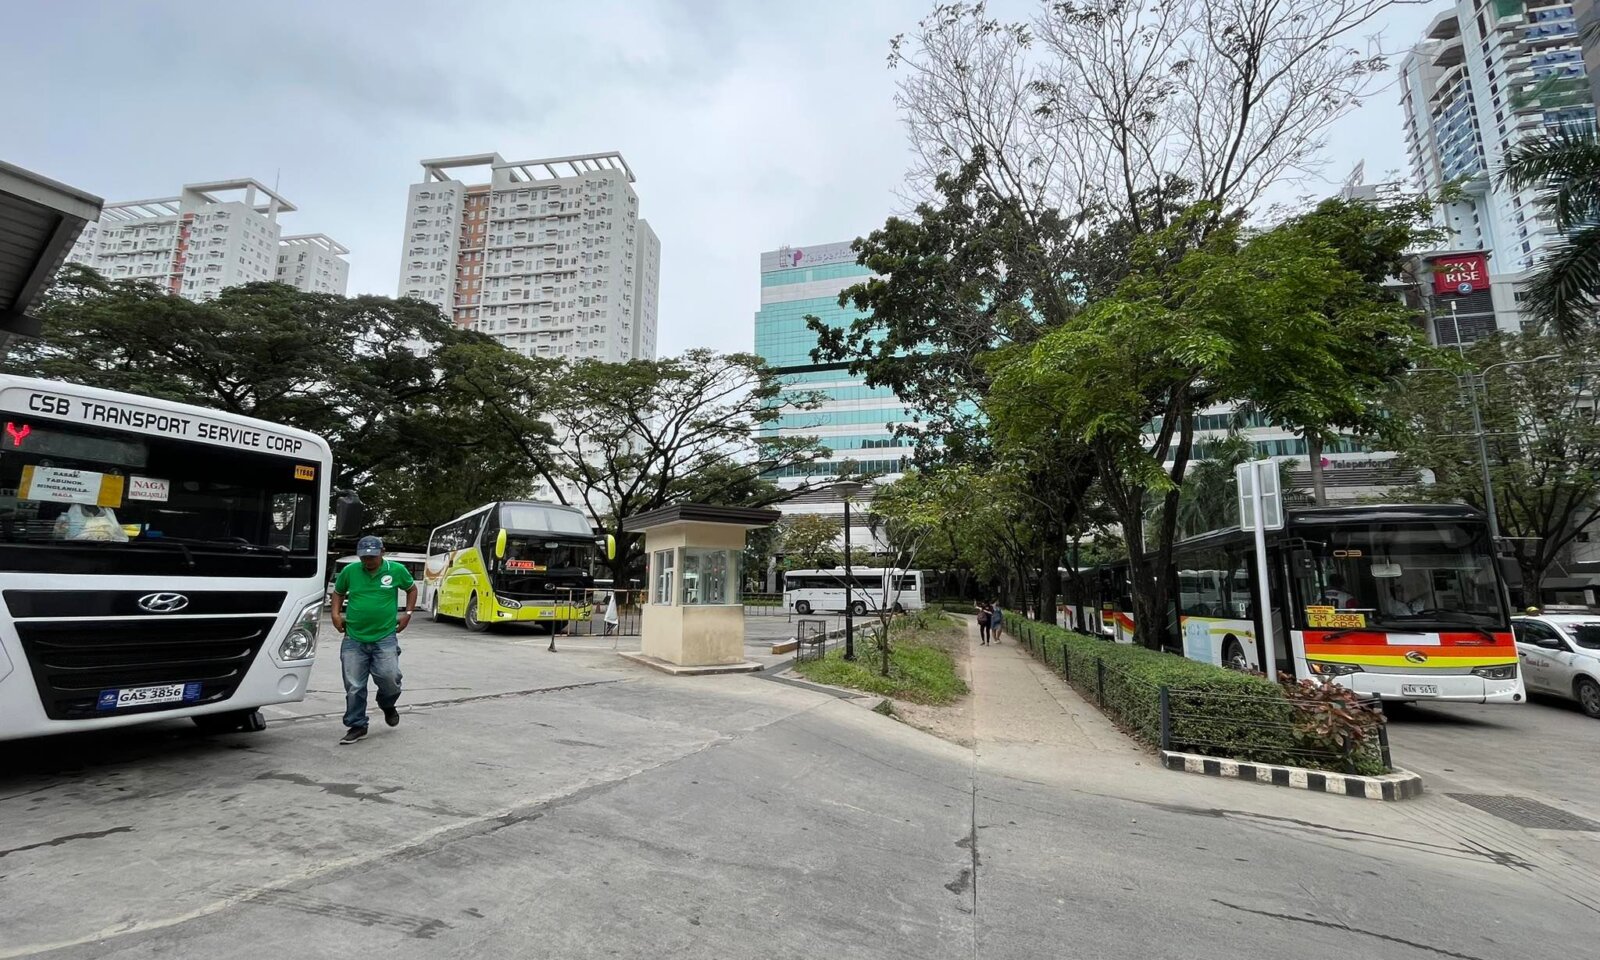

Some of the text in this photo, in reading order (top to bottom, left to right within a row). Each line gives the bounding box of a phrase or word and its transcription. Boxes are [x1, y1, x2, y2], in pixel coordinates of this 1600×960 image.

[1446, 271, 1480, 282] RISE
[29, 393, 303, 453] CSB TRANSPORT SERVICE CORP
[134, 480, 165, 490] NAGA
[120, 691, 147, 702] GAS
[150, 688, 181, 699] 3856
